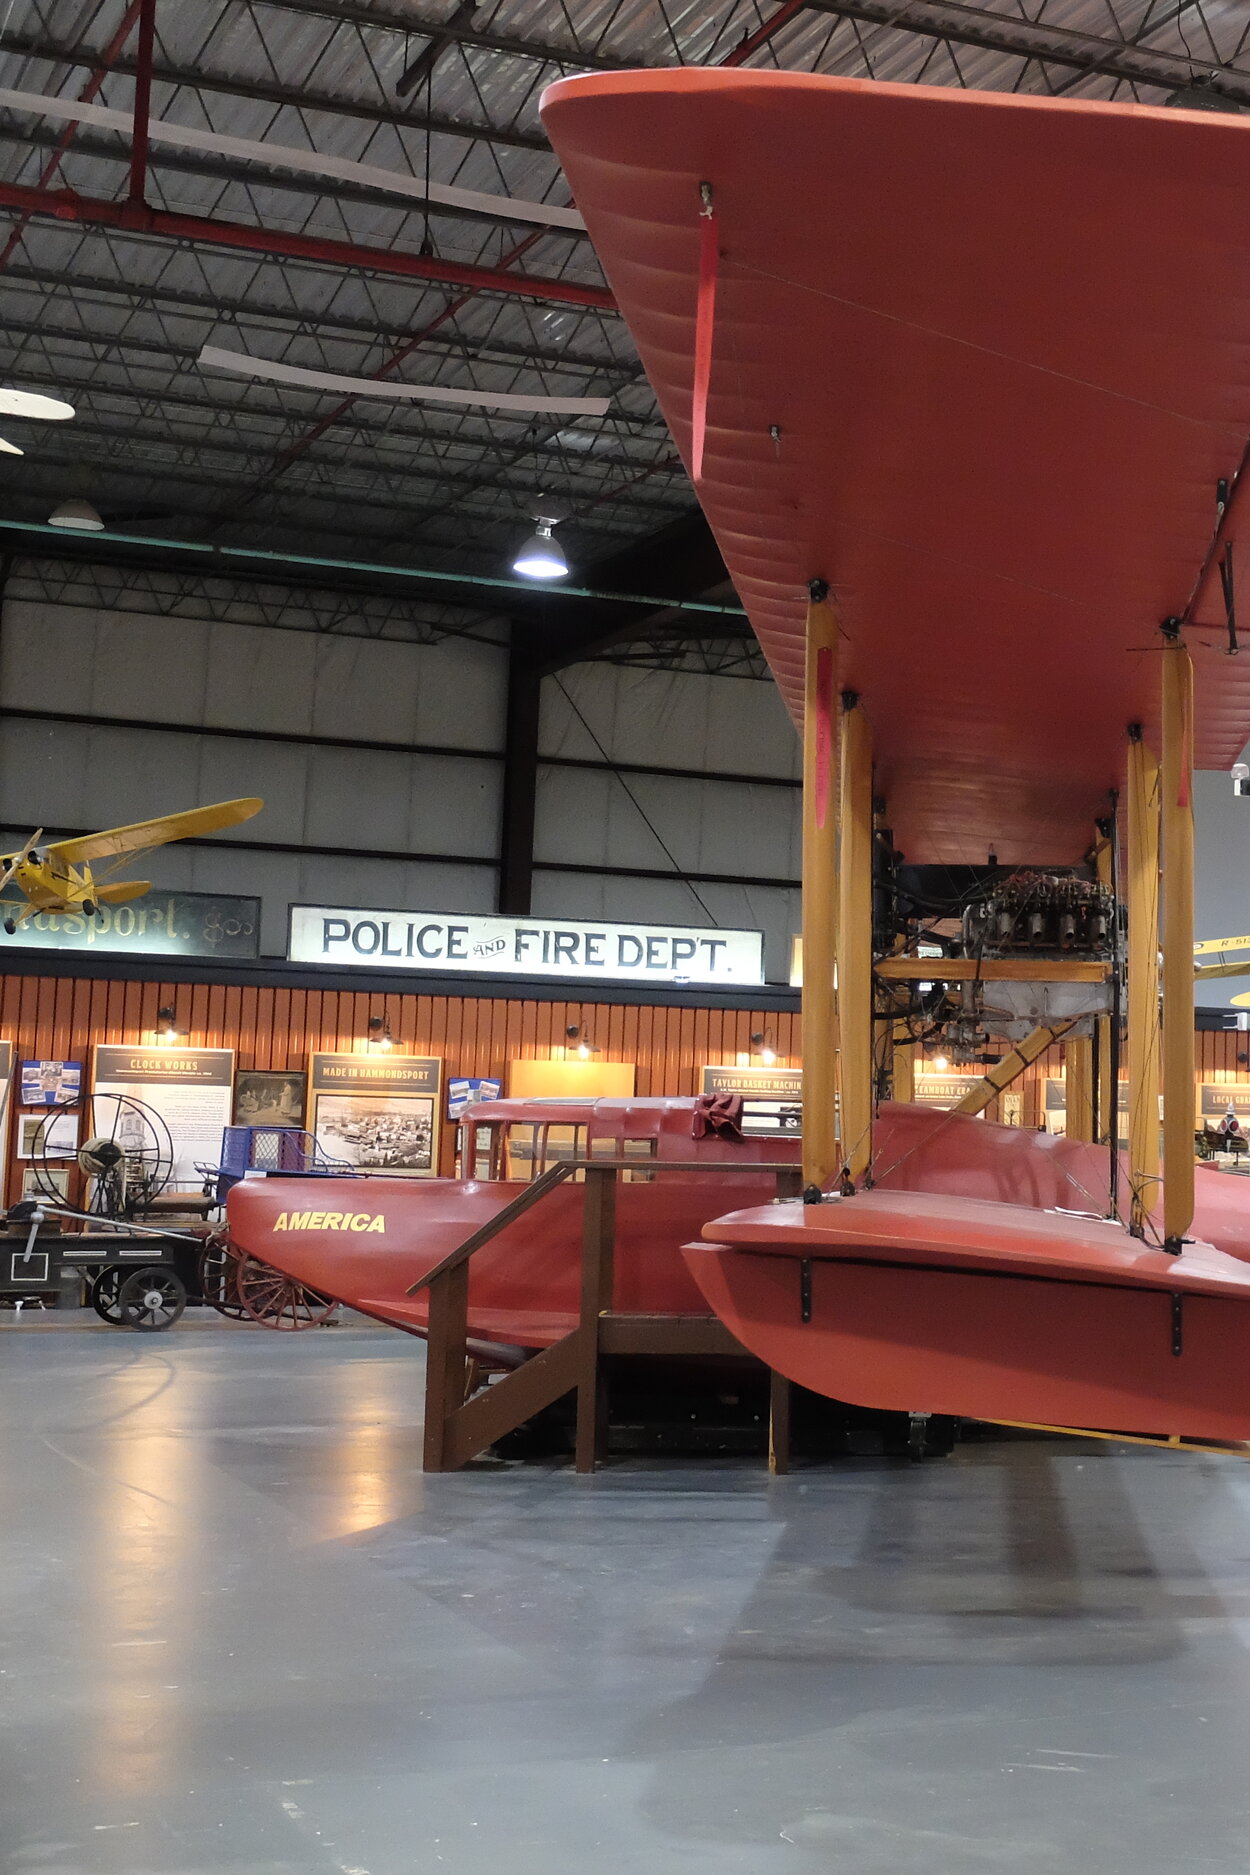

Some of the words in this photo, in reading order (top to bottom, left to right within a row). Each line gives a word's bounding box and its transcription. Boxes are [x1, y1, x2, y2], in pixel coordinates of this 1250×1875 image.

[322, 918, 469, 960] POLICE
[472, 938, 506, 957] AND
[514, 928, 606, 966] FIRE
[130, 1059, 161, 1070] CLOCK
[165, 1060, 198, 1071] WORKS
[323, 1067, 347, 1077] MADE
[349, 1068, 358, 1077] IN
[359, 1069, 429, 1080] HAMMONDSPORT
[712, 1078, 741, 1088] TAYLOR
[743, 1079, 771, 1089] BASKET
[1212, 1095, 1233, 1104] LOCAL
[273, 1211, 385, 1233] AMERICA
